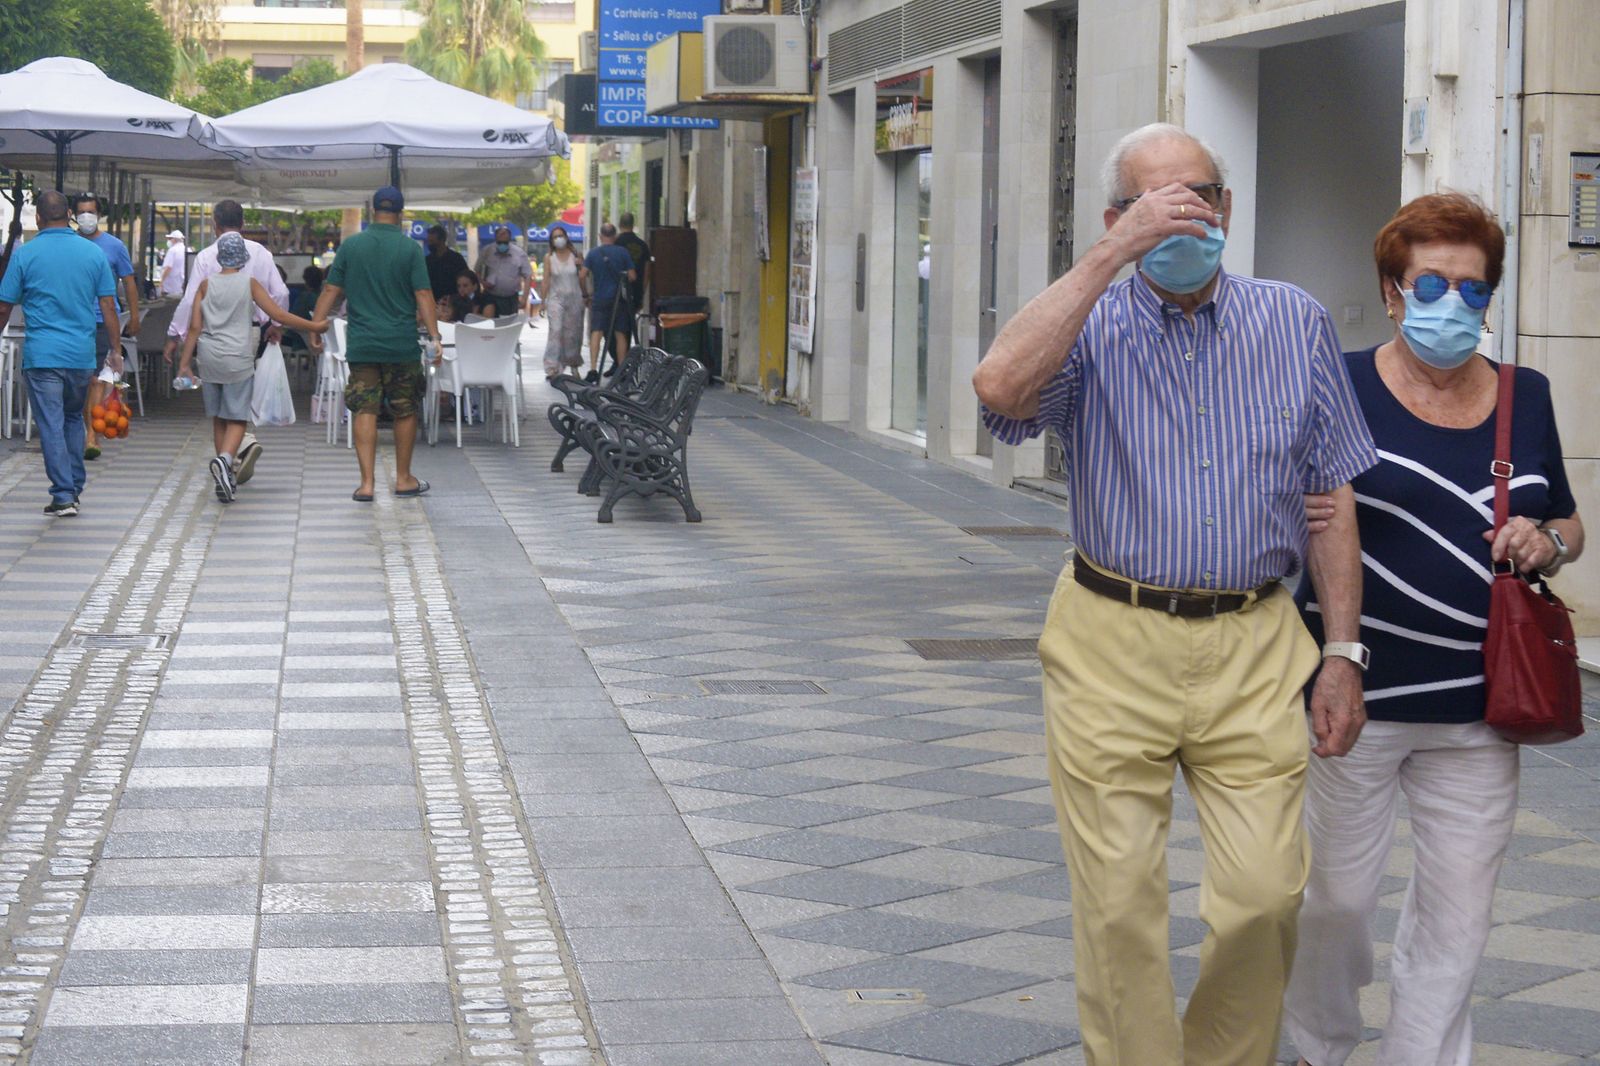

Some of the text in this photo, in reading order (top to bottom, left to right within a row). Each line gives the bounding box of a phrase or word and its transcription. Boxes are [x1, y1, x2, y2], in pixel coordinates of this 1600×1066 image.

[667, 9, 698, 19] Planos
[612, 30, 640, 41] Sellos
[642, 31, 654, 41] de
[601, 87, 646, 101] IMPR
